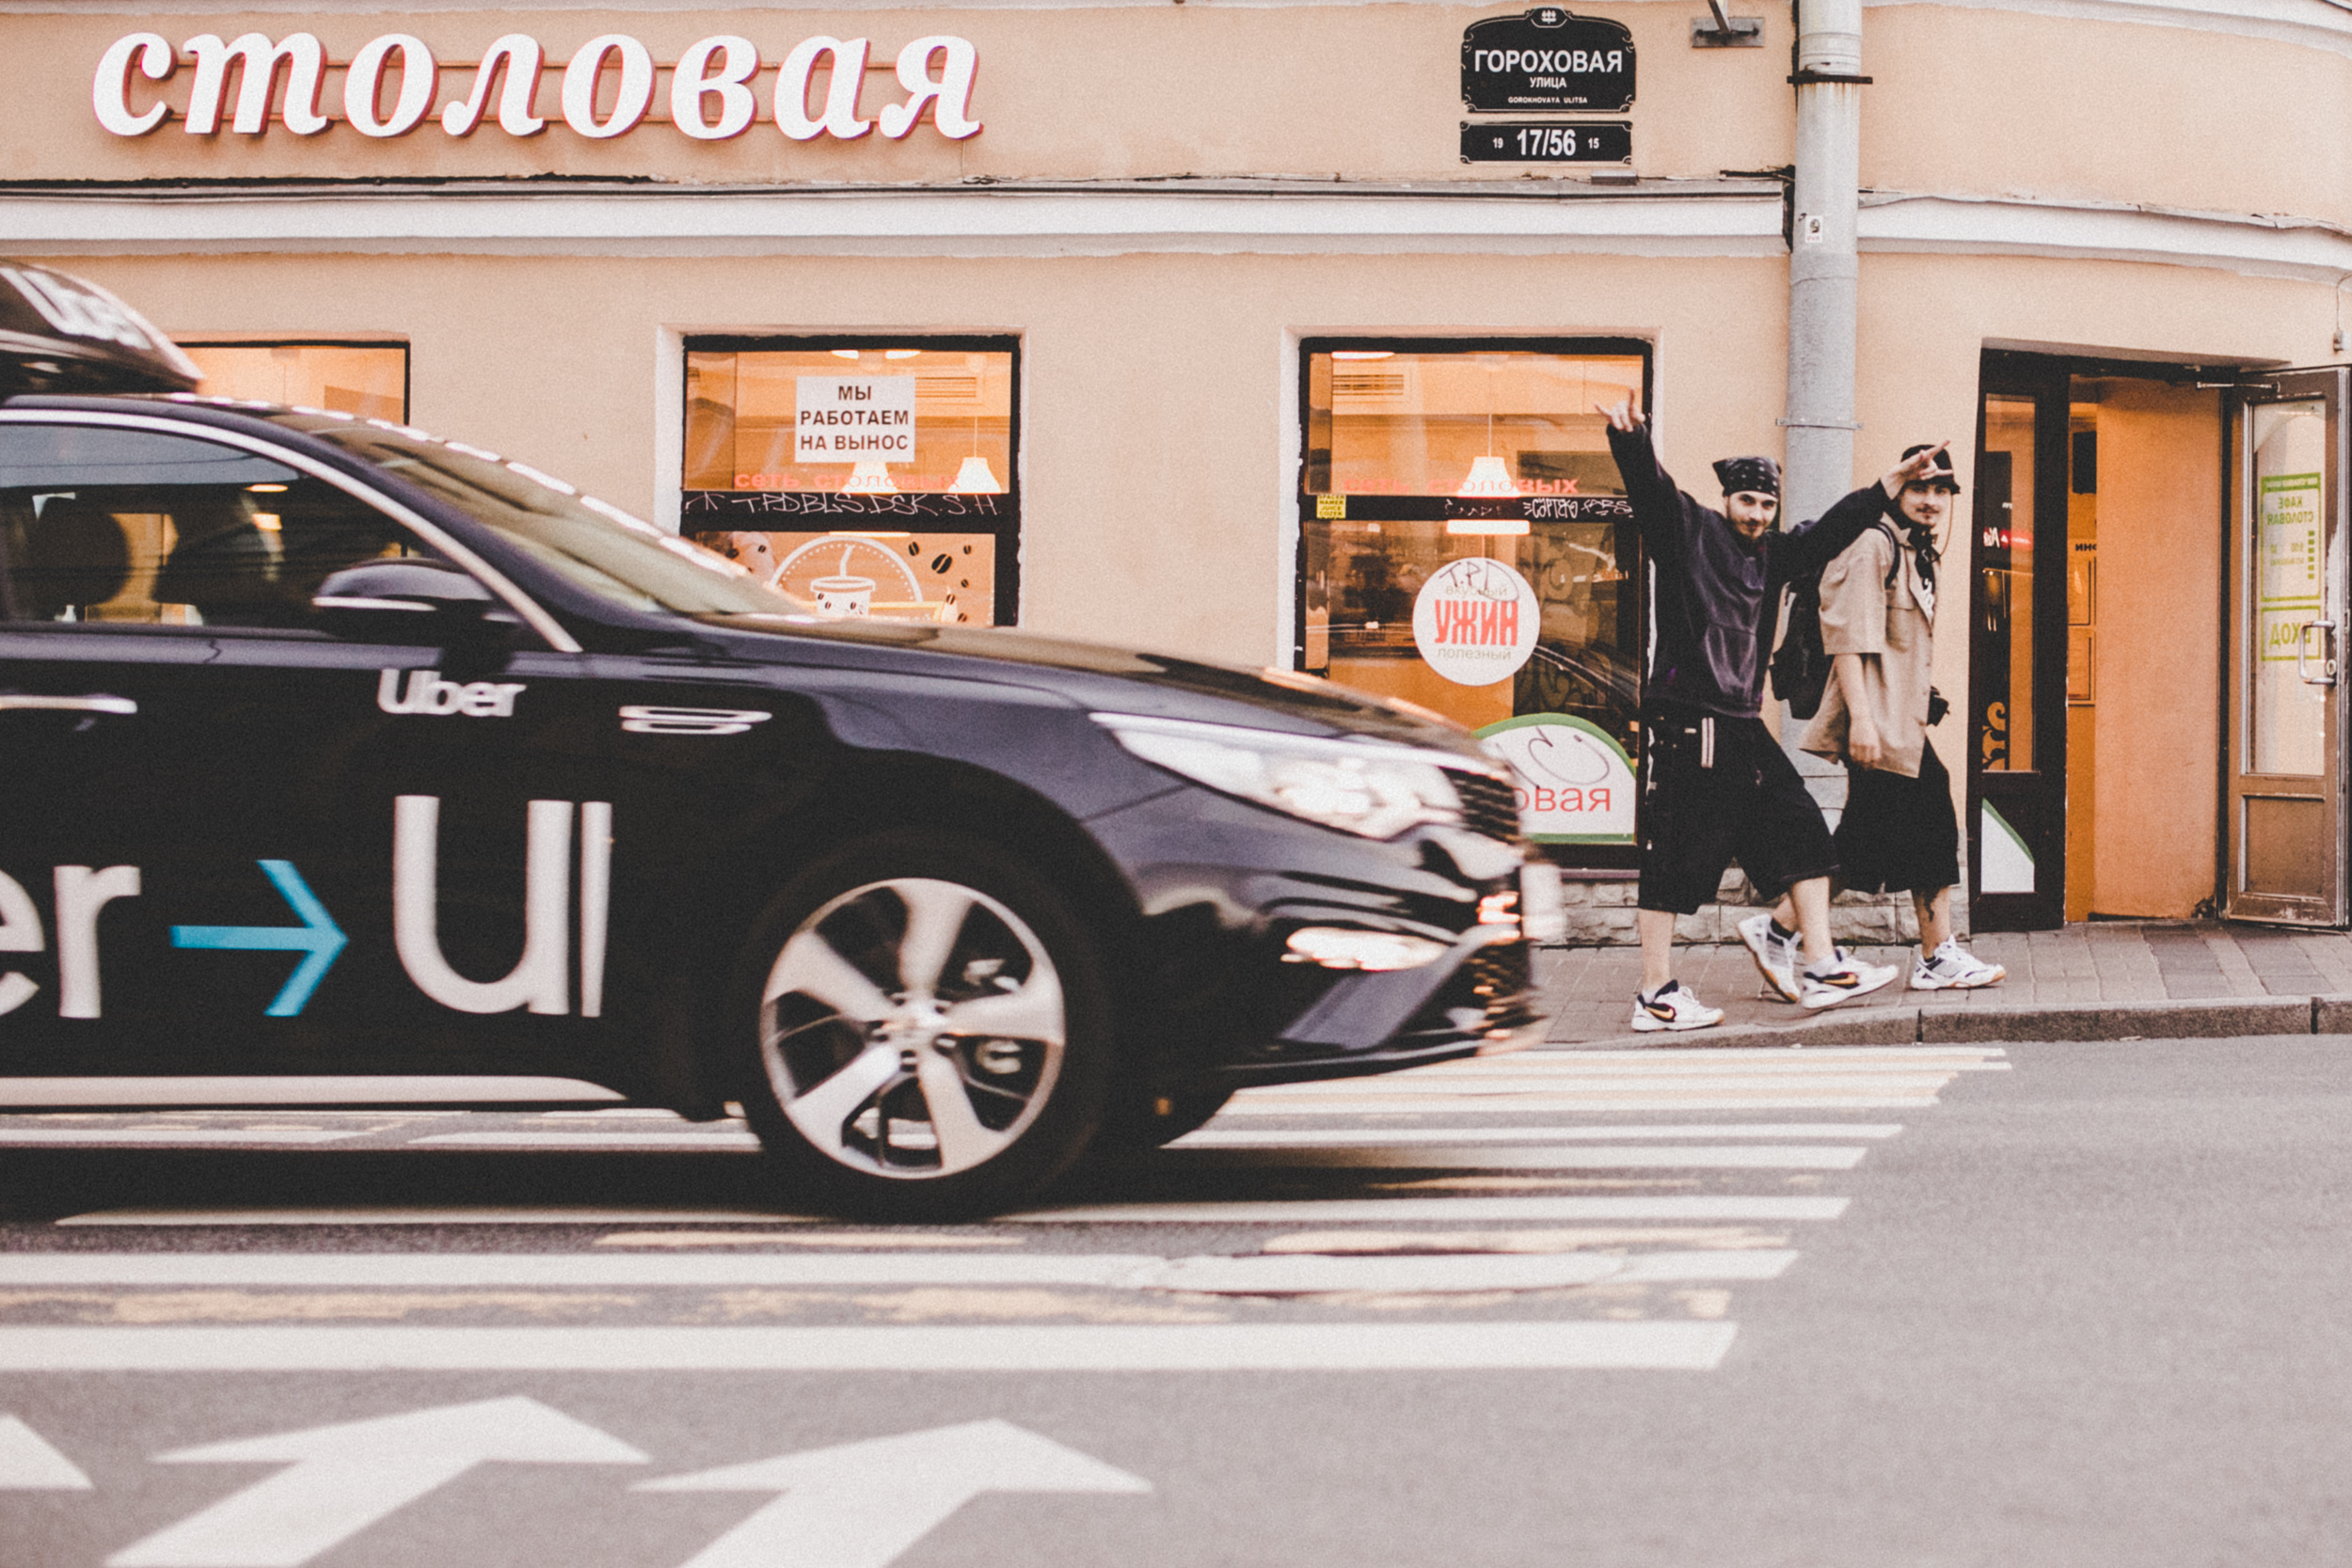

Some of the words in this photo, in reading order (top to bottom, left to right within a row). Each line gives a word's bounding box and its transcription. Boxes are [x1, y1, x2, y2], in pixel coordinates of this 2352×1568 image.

[1474, 50, 1622, 72] ГОРОХОВАЯ
[92, 32, 983, 140] столовая
[1529, 77, 1567, 89] УЛИЦА
[1493, 137, 1503, 149] 19
[1517, 129, 1576, 156] 17/56
[1588, 137, 1599, 149] 15
[837, 386, 872, 401] МЫ
[800, 410, 910, 426] РАБОТАЕМ
[800, 436, 827, 451] НА
[834, 435, 910, 451] ВЫНОС
[734, 473, 801, 488] сеть
[1427, 479, 1578, 494] столовых
[1434, 599, 1518, 646] УЖИН
[1438, 647, 1512, 660] полезный
[377, 669, 527, 717] Uber
